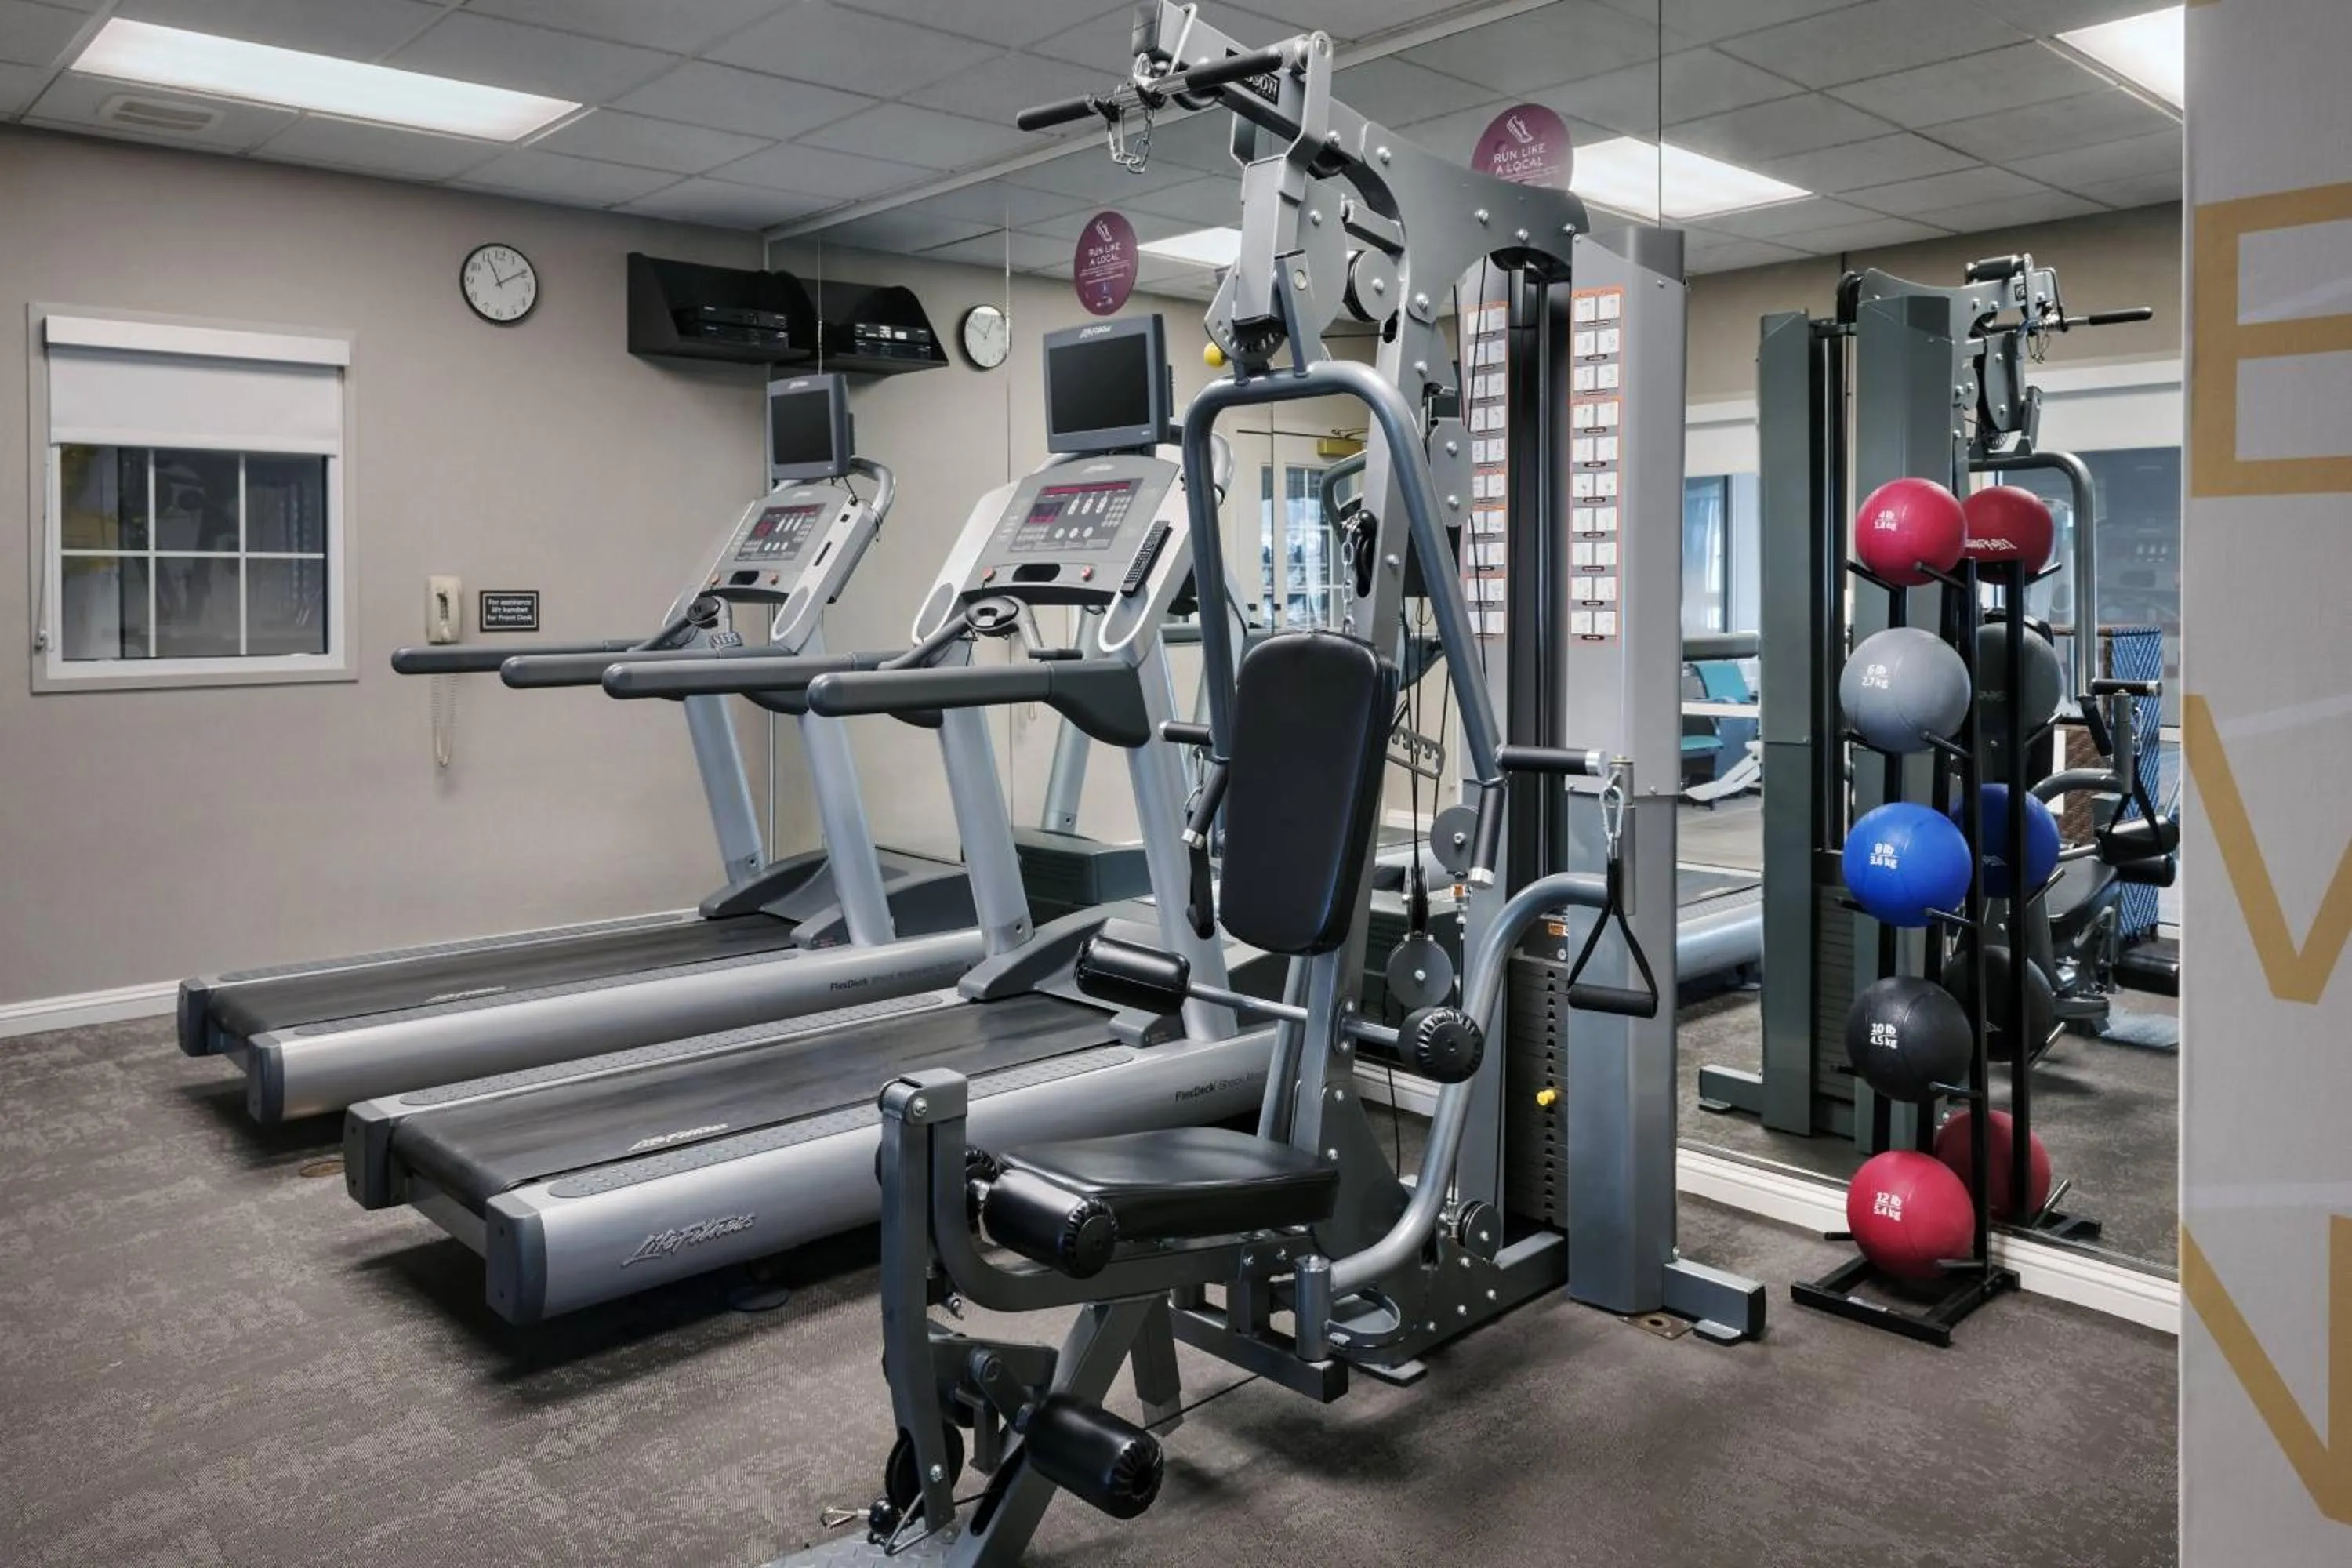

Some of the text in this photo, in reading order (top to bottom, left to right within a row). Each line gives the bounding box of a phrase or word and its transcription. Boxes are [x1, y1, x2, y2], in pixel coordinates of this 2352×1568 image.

[1494, 143, 1547, 165] RUN LIKE
[1505, 157, 1544, 173] LOCAL
[1875, 677, 1889, 689] kg
[1884, 856, 1898, 869] kg
[1871, 1023, 1896, 1035] 10 lb
[1870, 1036, 1898, 1049] 4.5 kg
[1876, 1192, 1901, 1207] 12 lb
[1888, 1207, 1901, 1221] kg
